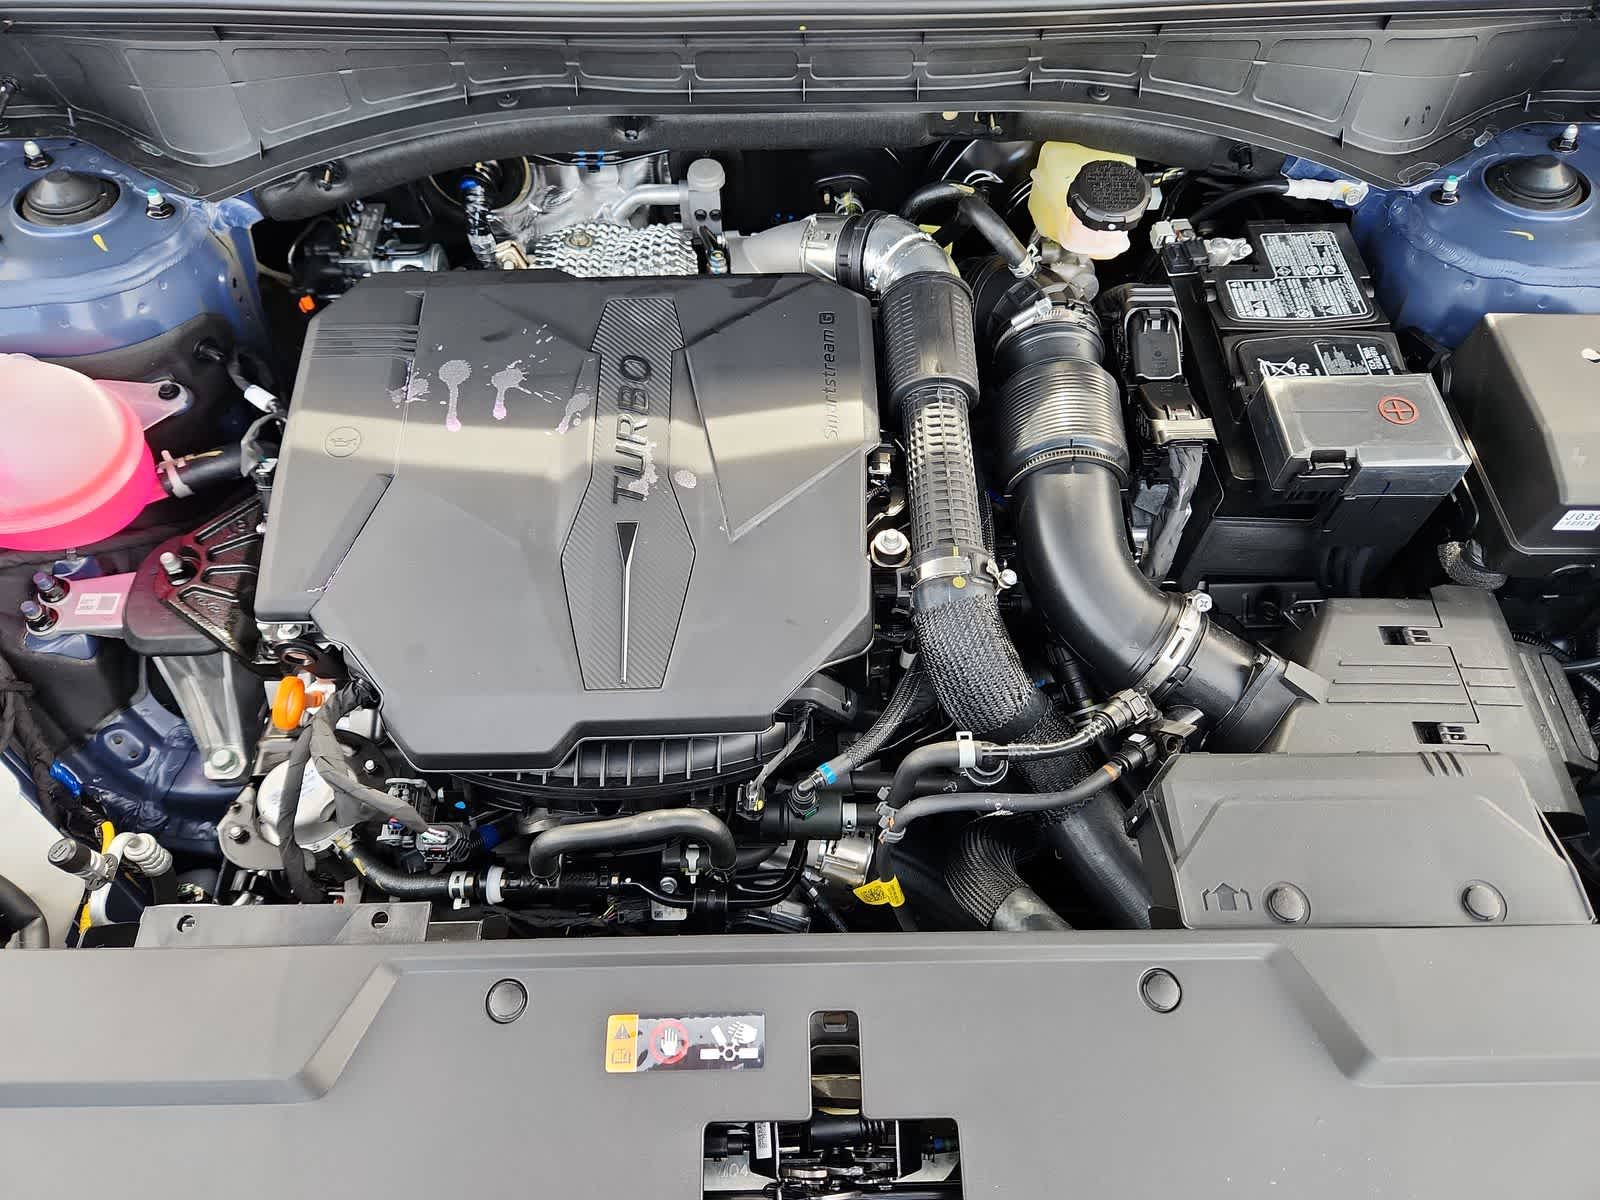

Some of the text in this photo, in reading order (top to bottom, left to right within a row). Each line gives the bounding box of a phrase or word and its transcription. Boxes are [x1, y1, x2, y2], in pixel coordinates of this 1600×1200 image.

[818, 312, 835, 325] G
[1297, 363, 1312, 376] Pb
[612, 354, 652, 505] TURBO
